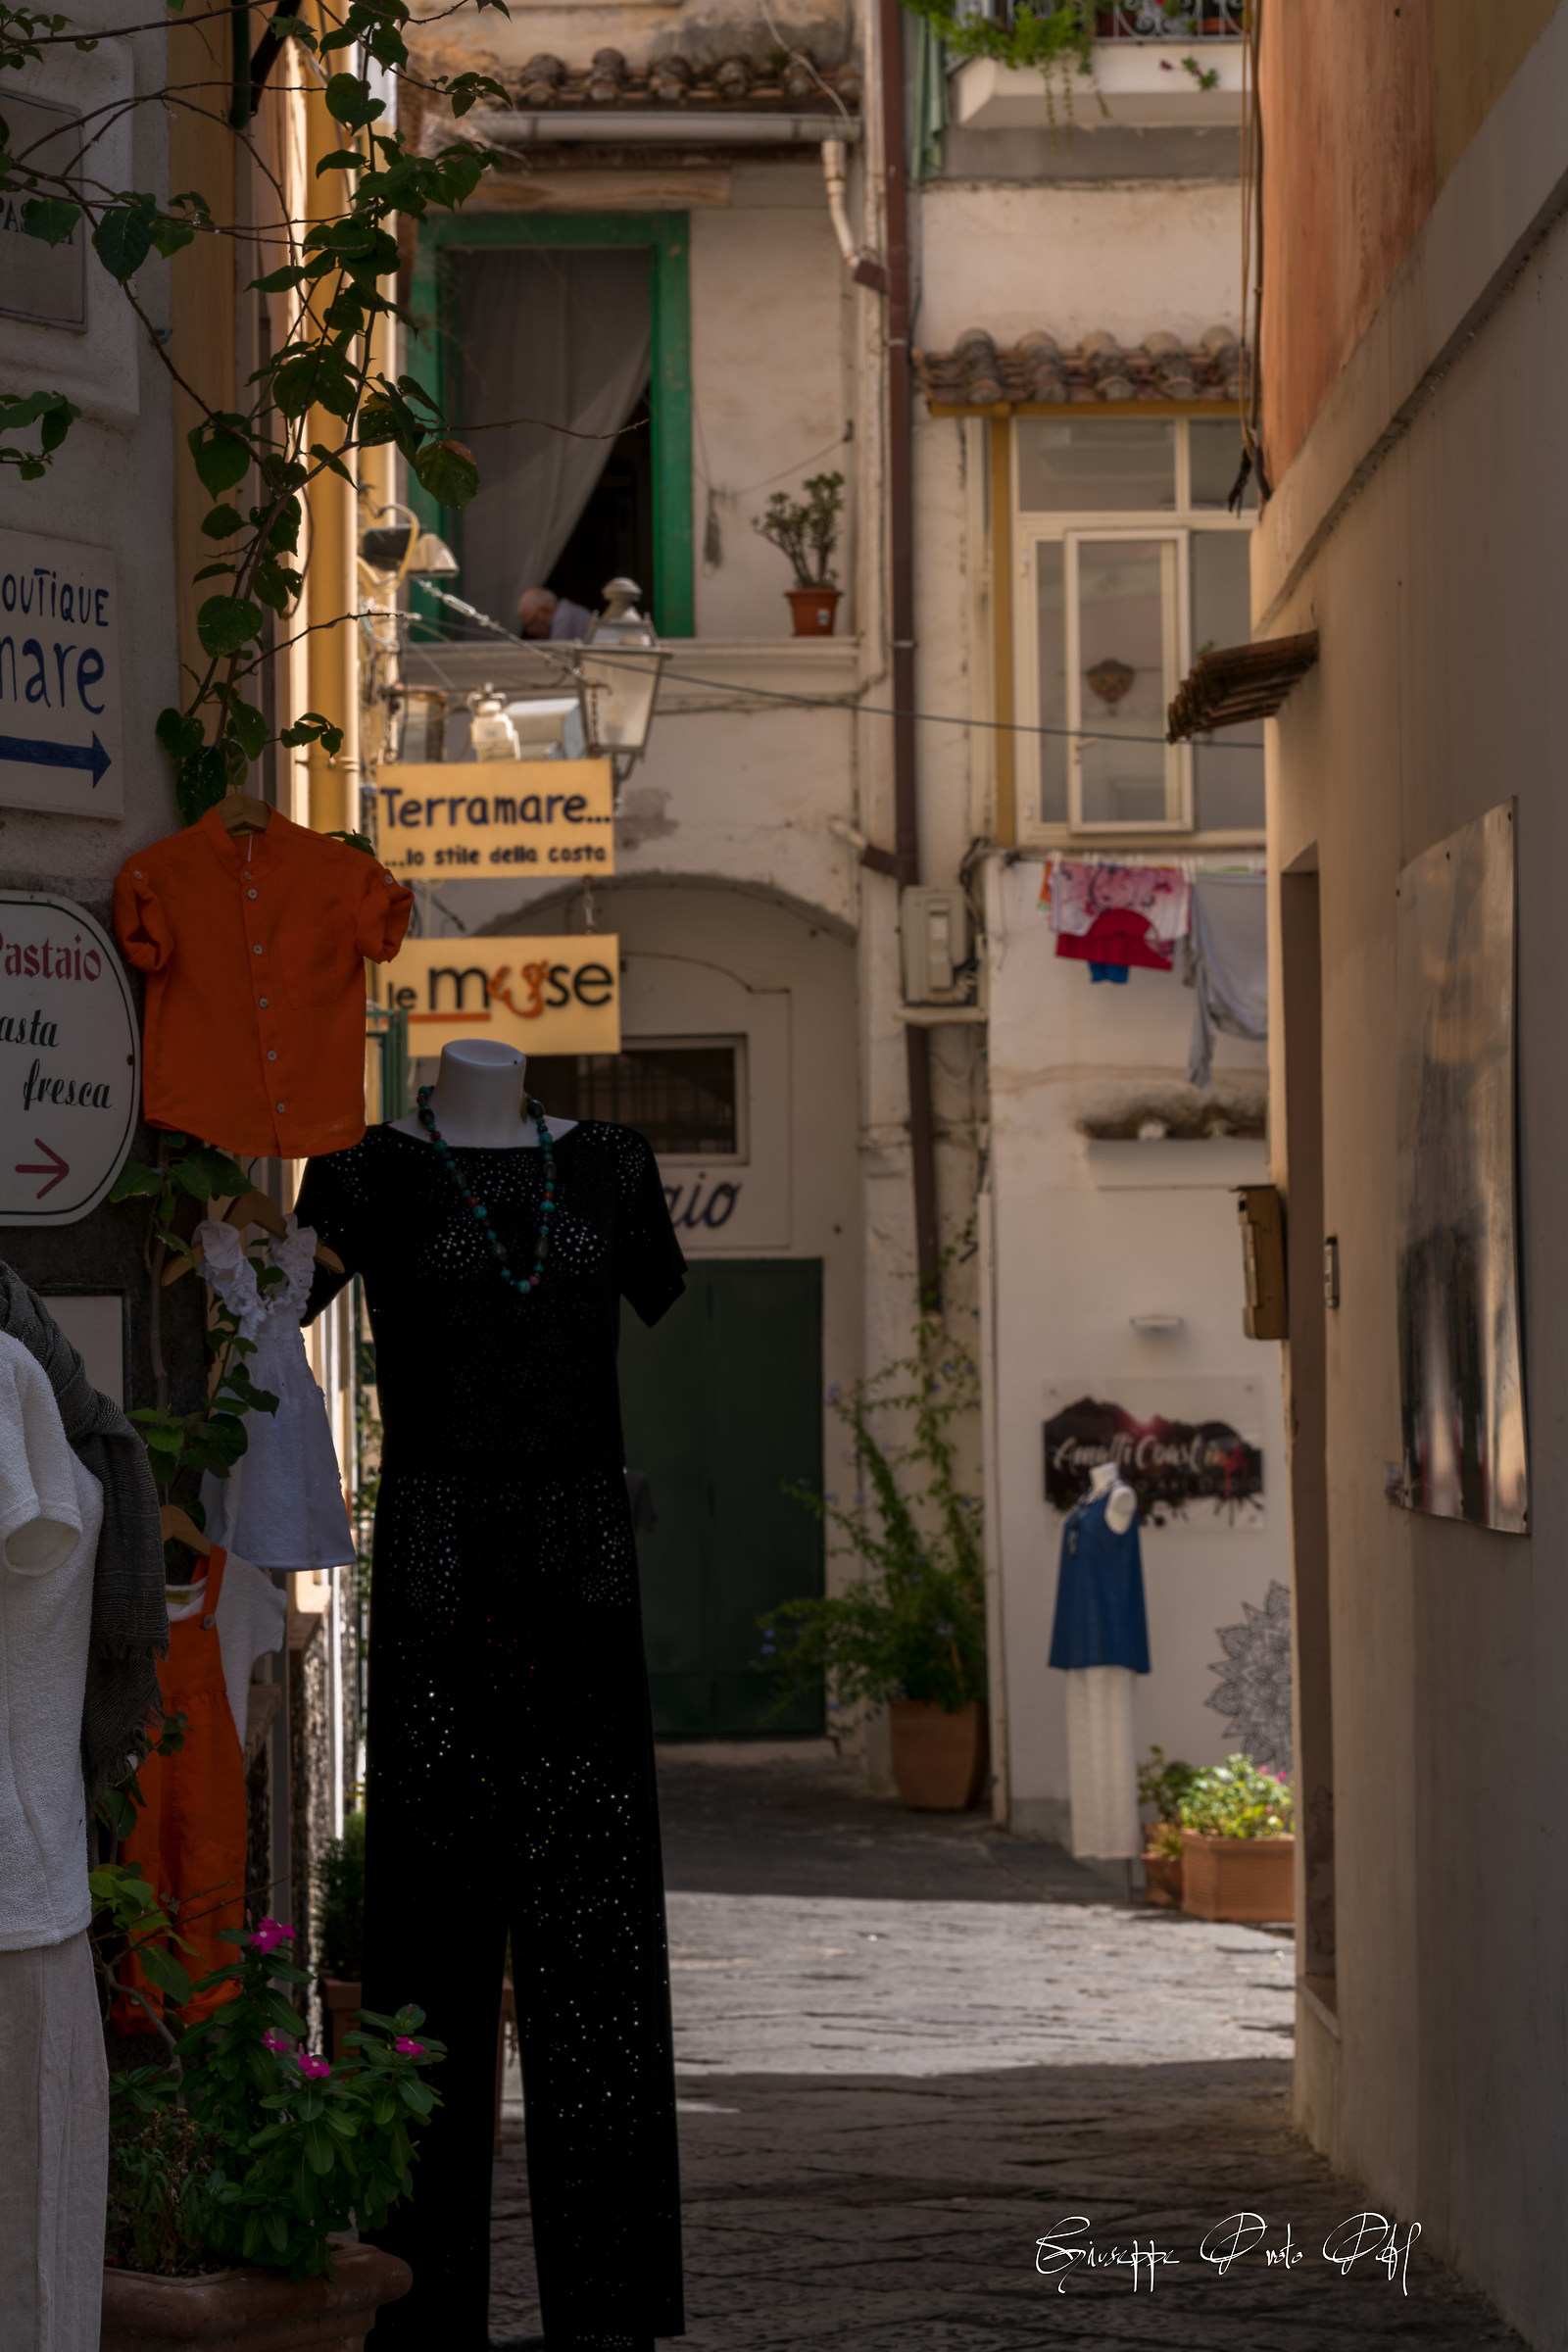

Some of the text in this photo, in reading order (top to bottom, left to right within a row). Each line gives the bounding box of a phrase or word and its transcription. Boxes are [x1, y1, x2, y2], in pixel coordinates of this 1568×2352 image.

[434, 844, 480, 865] stile
[489, 845, 537, 864] della
[548, 844, 606, 862] costa
[0, 931, 101, 982] astaio
[23, 1058, 112, 1111] fresca
